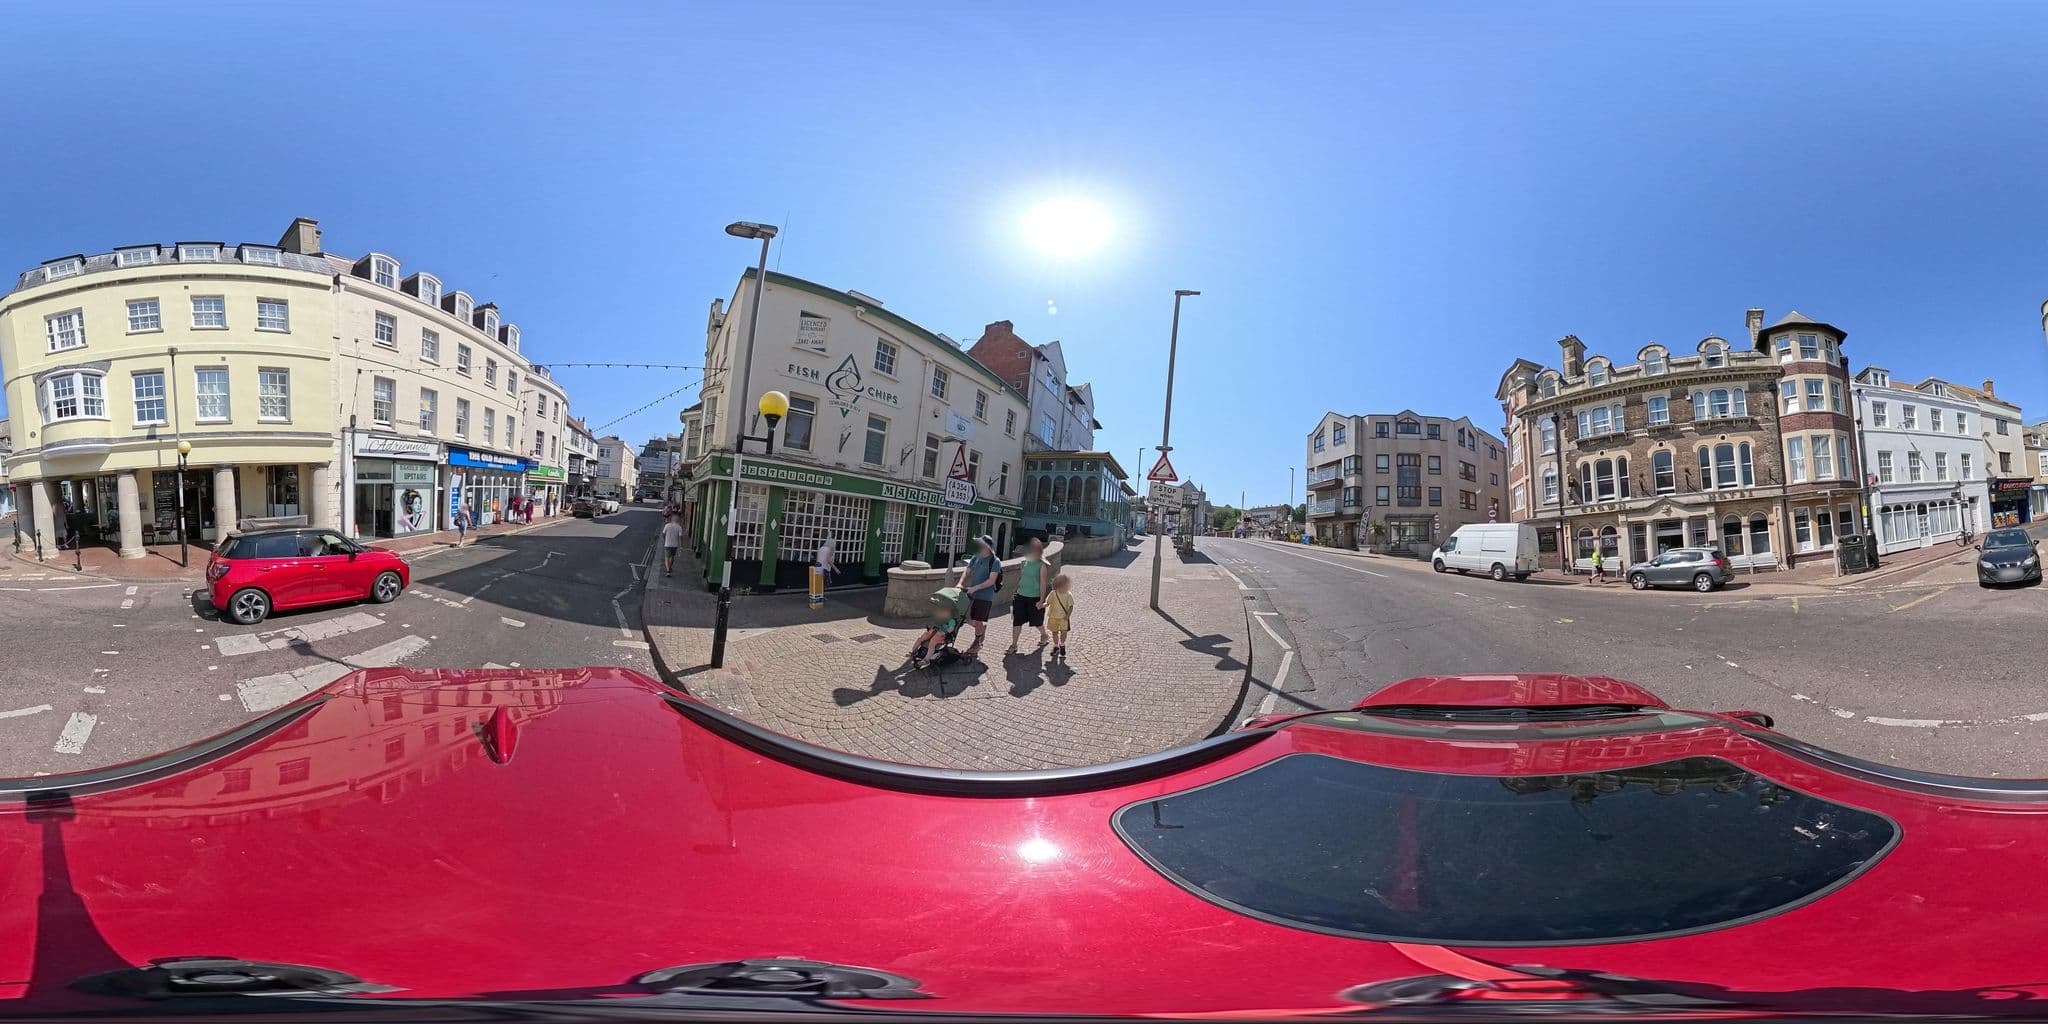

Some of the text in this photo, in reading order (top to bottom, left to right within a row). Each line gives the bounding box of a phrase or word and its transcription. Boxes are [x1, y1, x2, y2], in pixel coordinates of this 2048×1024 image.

[788, 364, 820, 380] FISH
[867, 386, 898, 405] CHIPS
[469, 451, 481, 461] THE
[481, 454, 493, 463] OLD
[1158, 485, 1177, 494] STOP
[1581, 502, 1627, 513] CROWN
